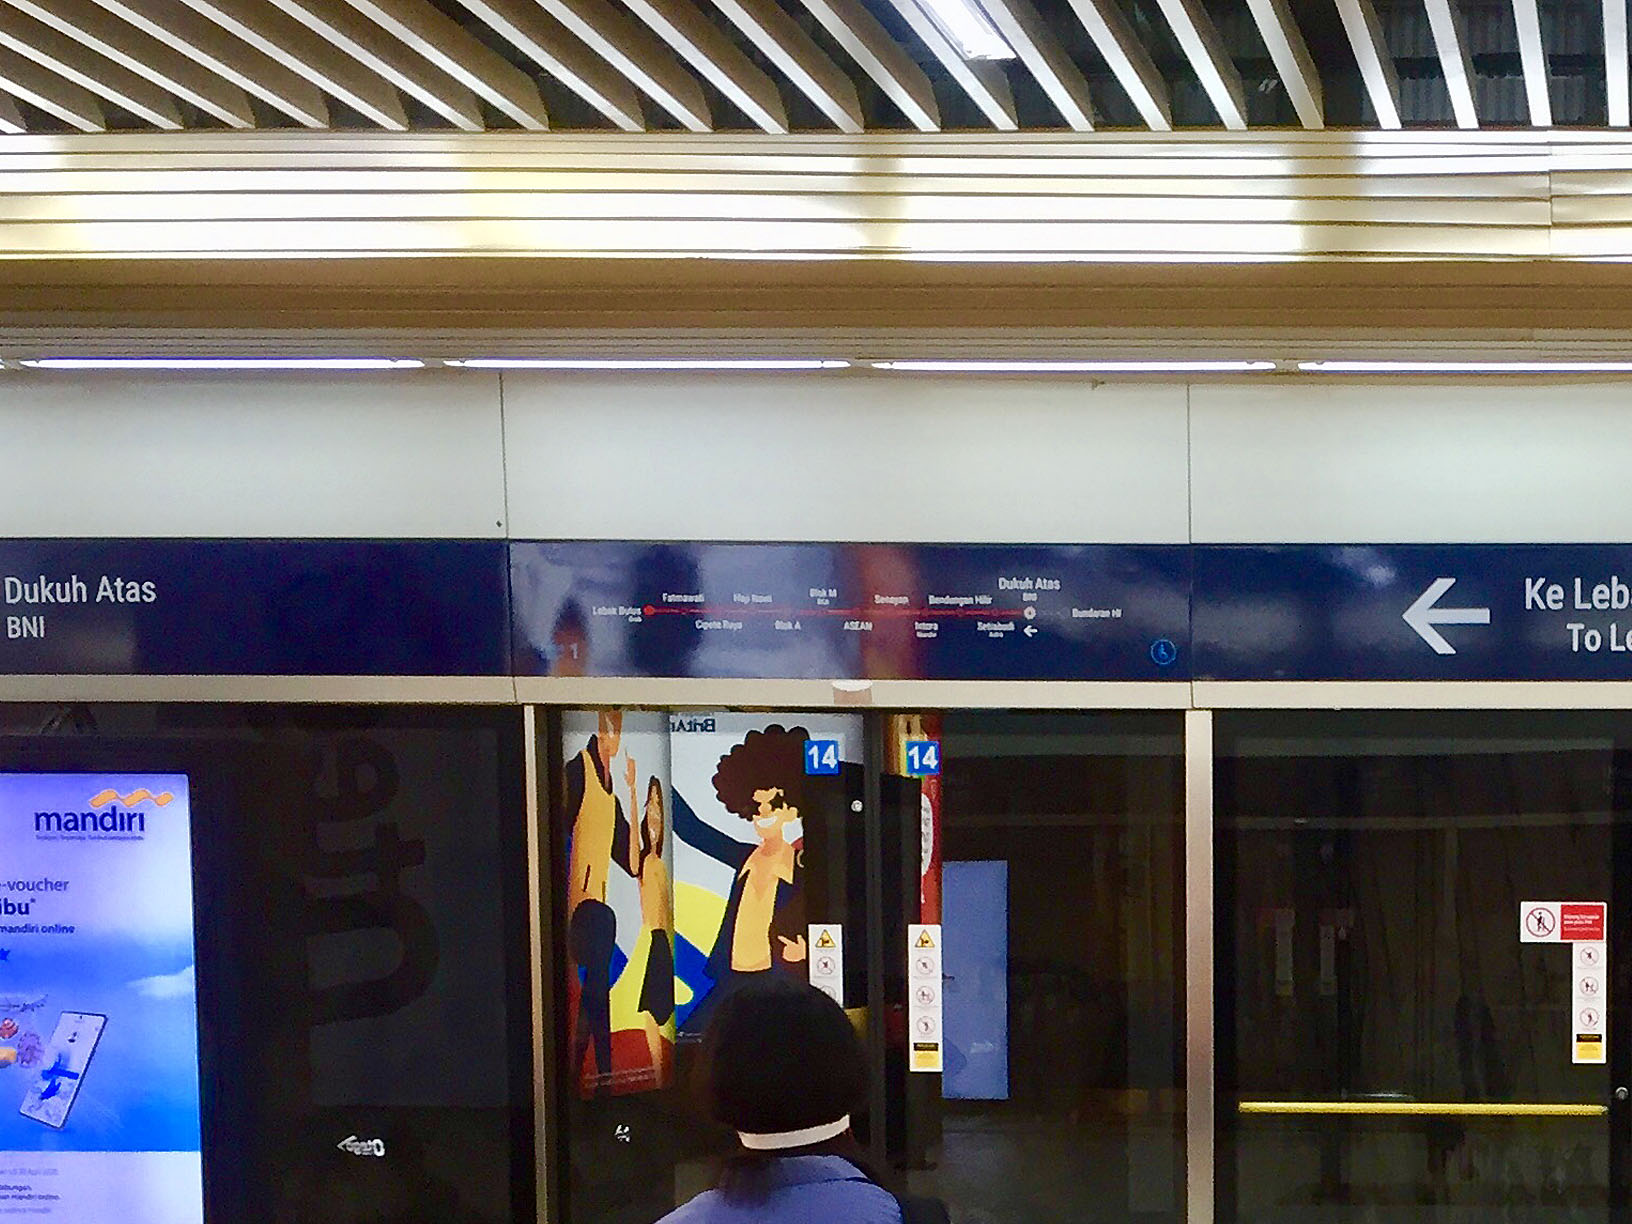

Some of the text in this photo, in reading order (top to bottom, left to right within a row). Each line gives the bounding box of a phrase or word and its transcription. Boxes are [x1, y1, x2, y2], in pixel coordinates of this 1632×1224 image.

[5, 575, 157, 603] Dukuh Atas
[999, 577, 1061, 590] Dukuh Atas
[1525, 577, 1563, 610] Ke
[7, 615, 45, 638] BNI
[1567, 623, 1601, 652] To
[807, 744, 838, 769] 14
[907, 744, 938, 769] 14
[34, 805, 145, 832] mandiri
[0, 877, 69, 892] -voucher
